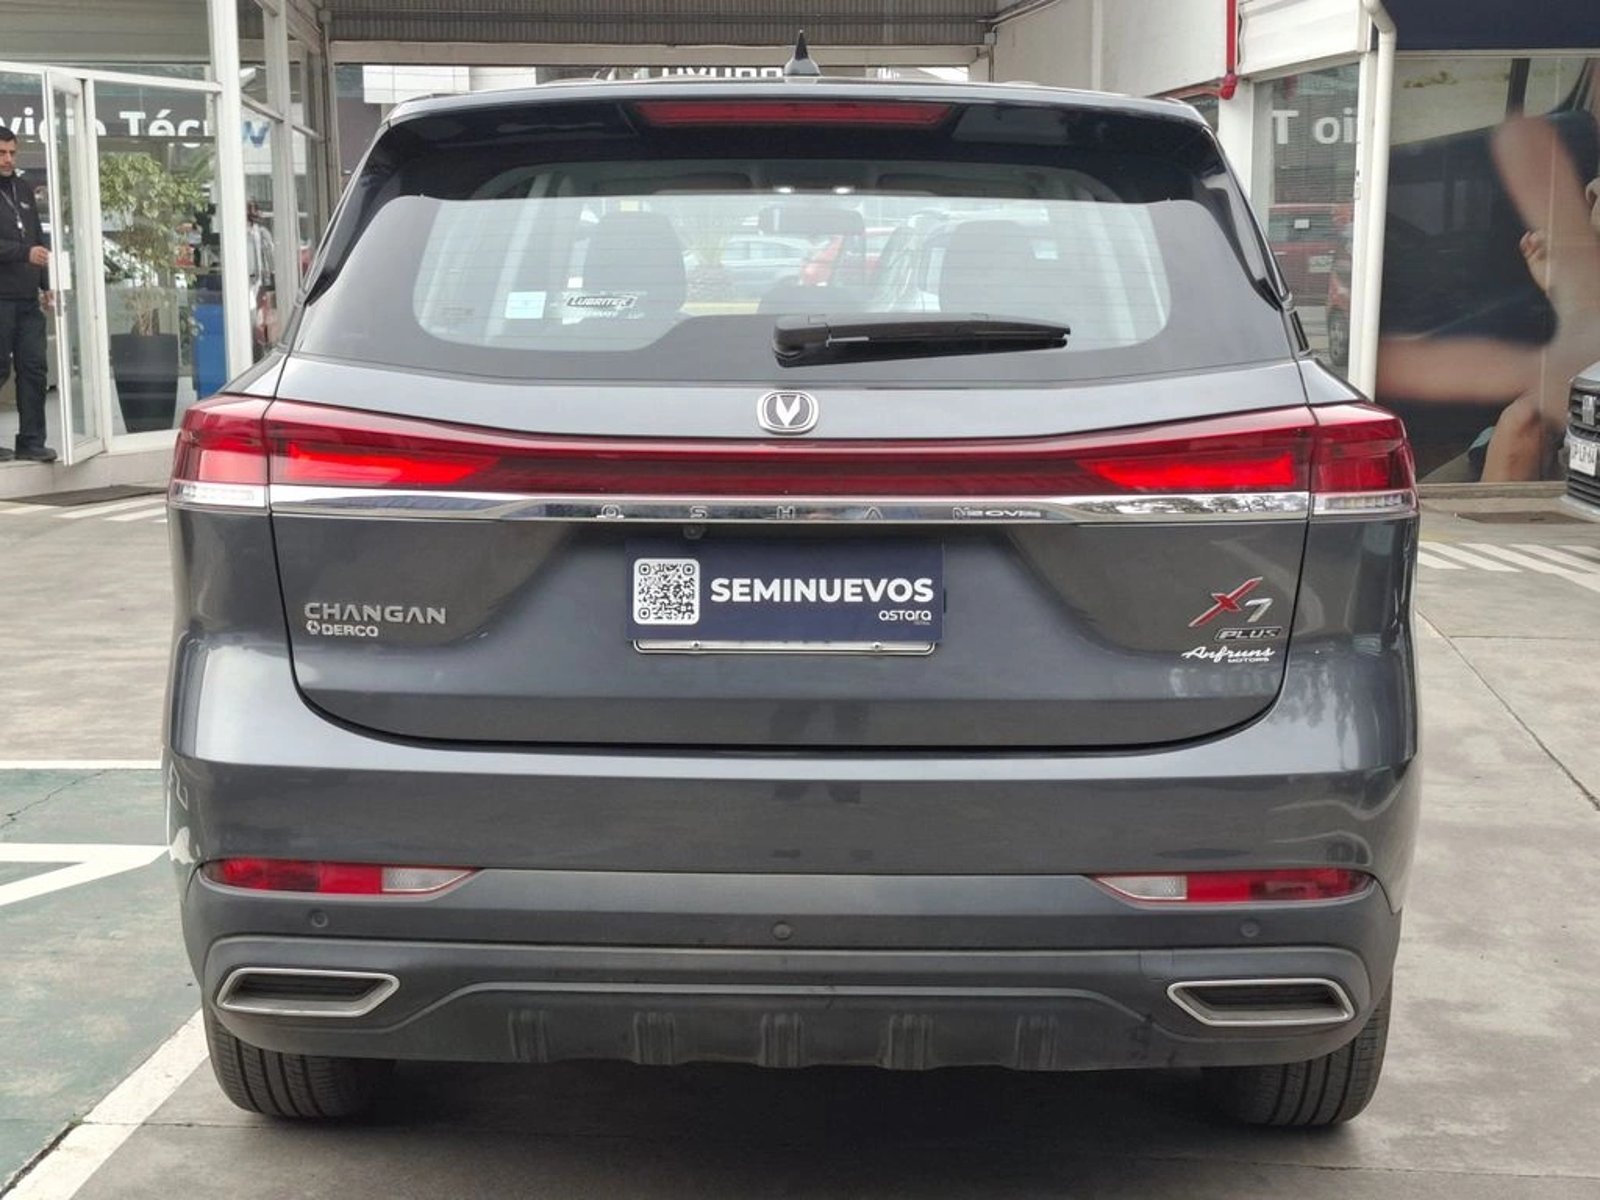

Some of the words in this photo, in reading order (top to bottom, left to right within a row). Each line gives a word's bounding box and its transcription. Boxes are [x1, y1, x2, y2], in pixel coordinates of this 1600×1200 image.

[119, 109, 209, 147] Téc
[710, 578, 935, 603] SEMINUEVOS
[304, 602, 447, 625] CHANGAN
[878, 609, 932, 622] astara
[321, 624, 379, 638] DERCO
[1218, 629, 1278, 640] PLUS
